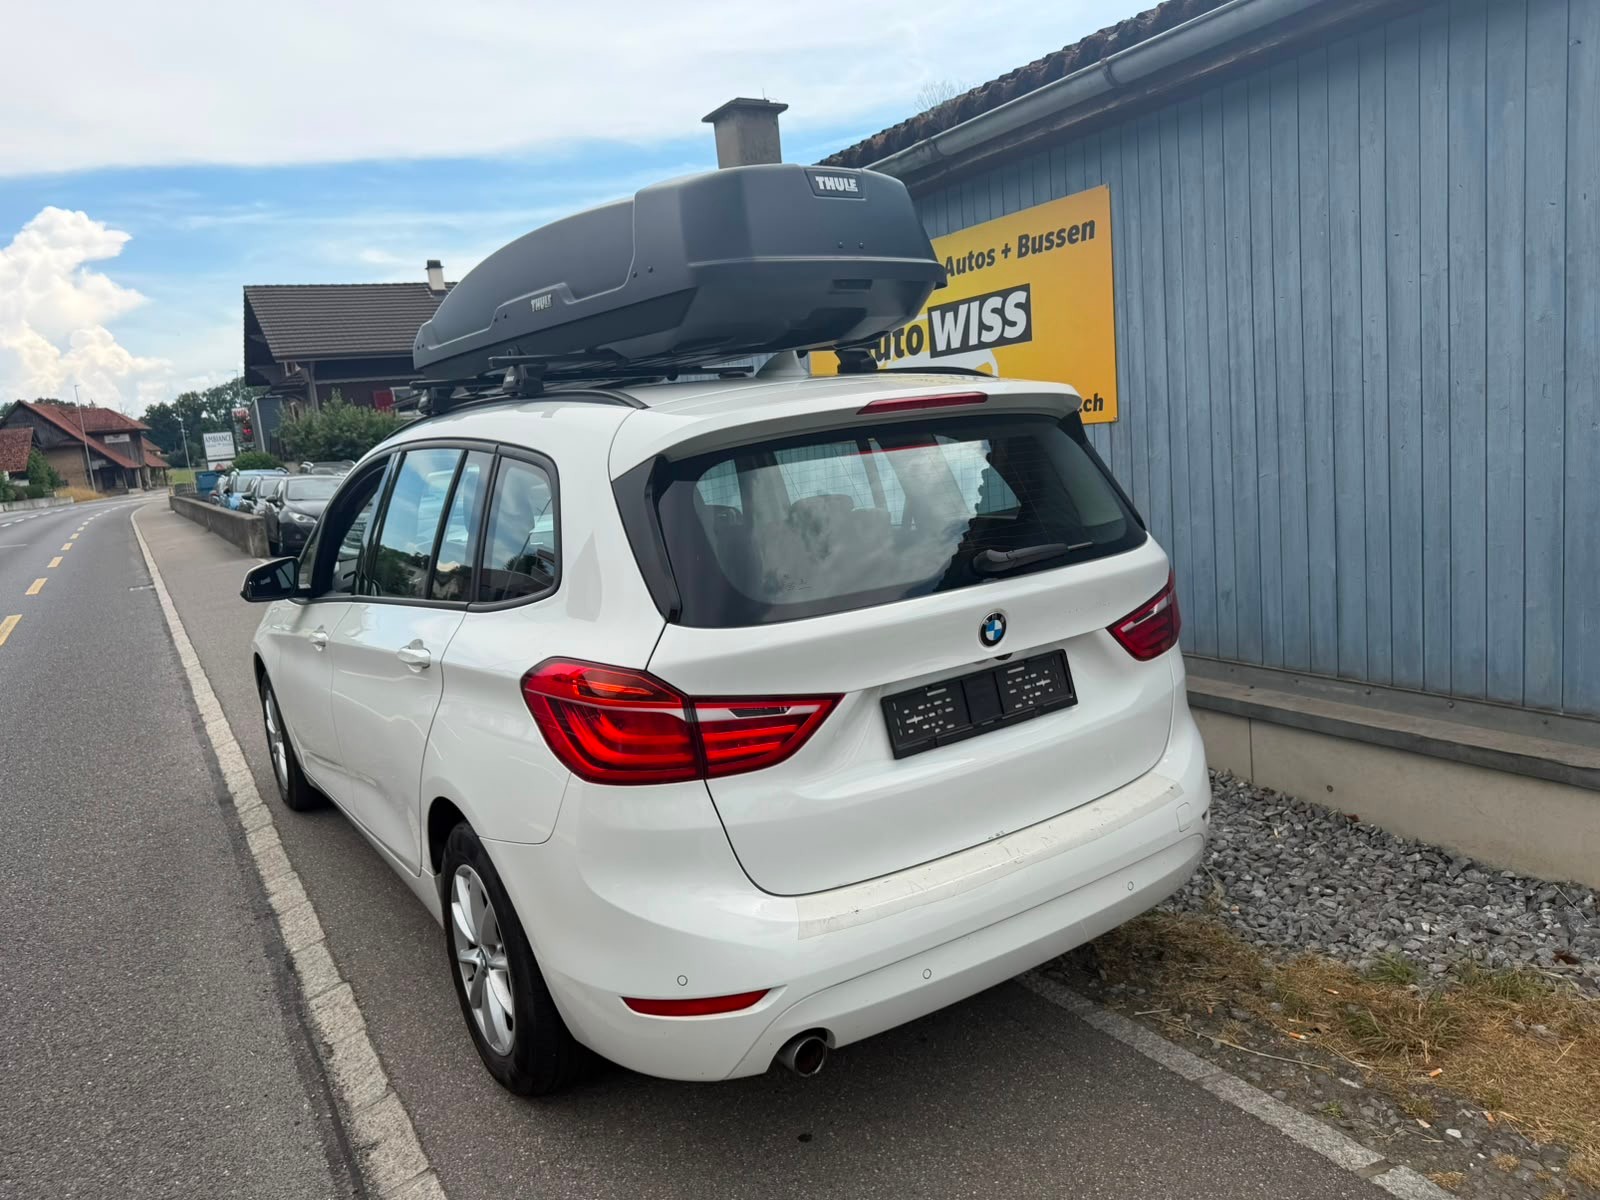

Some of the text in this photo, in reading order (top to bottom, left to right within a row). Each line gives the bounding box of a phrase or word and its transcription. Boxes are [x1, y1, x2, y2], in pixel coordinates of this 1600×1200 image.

[815, 175, 858, 192] THULE
[945, 219, 1095, 277] Autos + Bussen
[531, 294, 552, 312] THULE
[875, 290, 1027, 362] uto WISS
[1079, 393, 1104, 412] .ch
[205, 434, 232, 442] AMBIANCE
